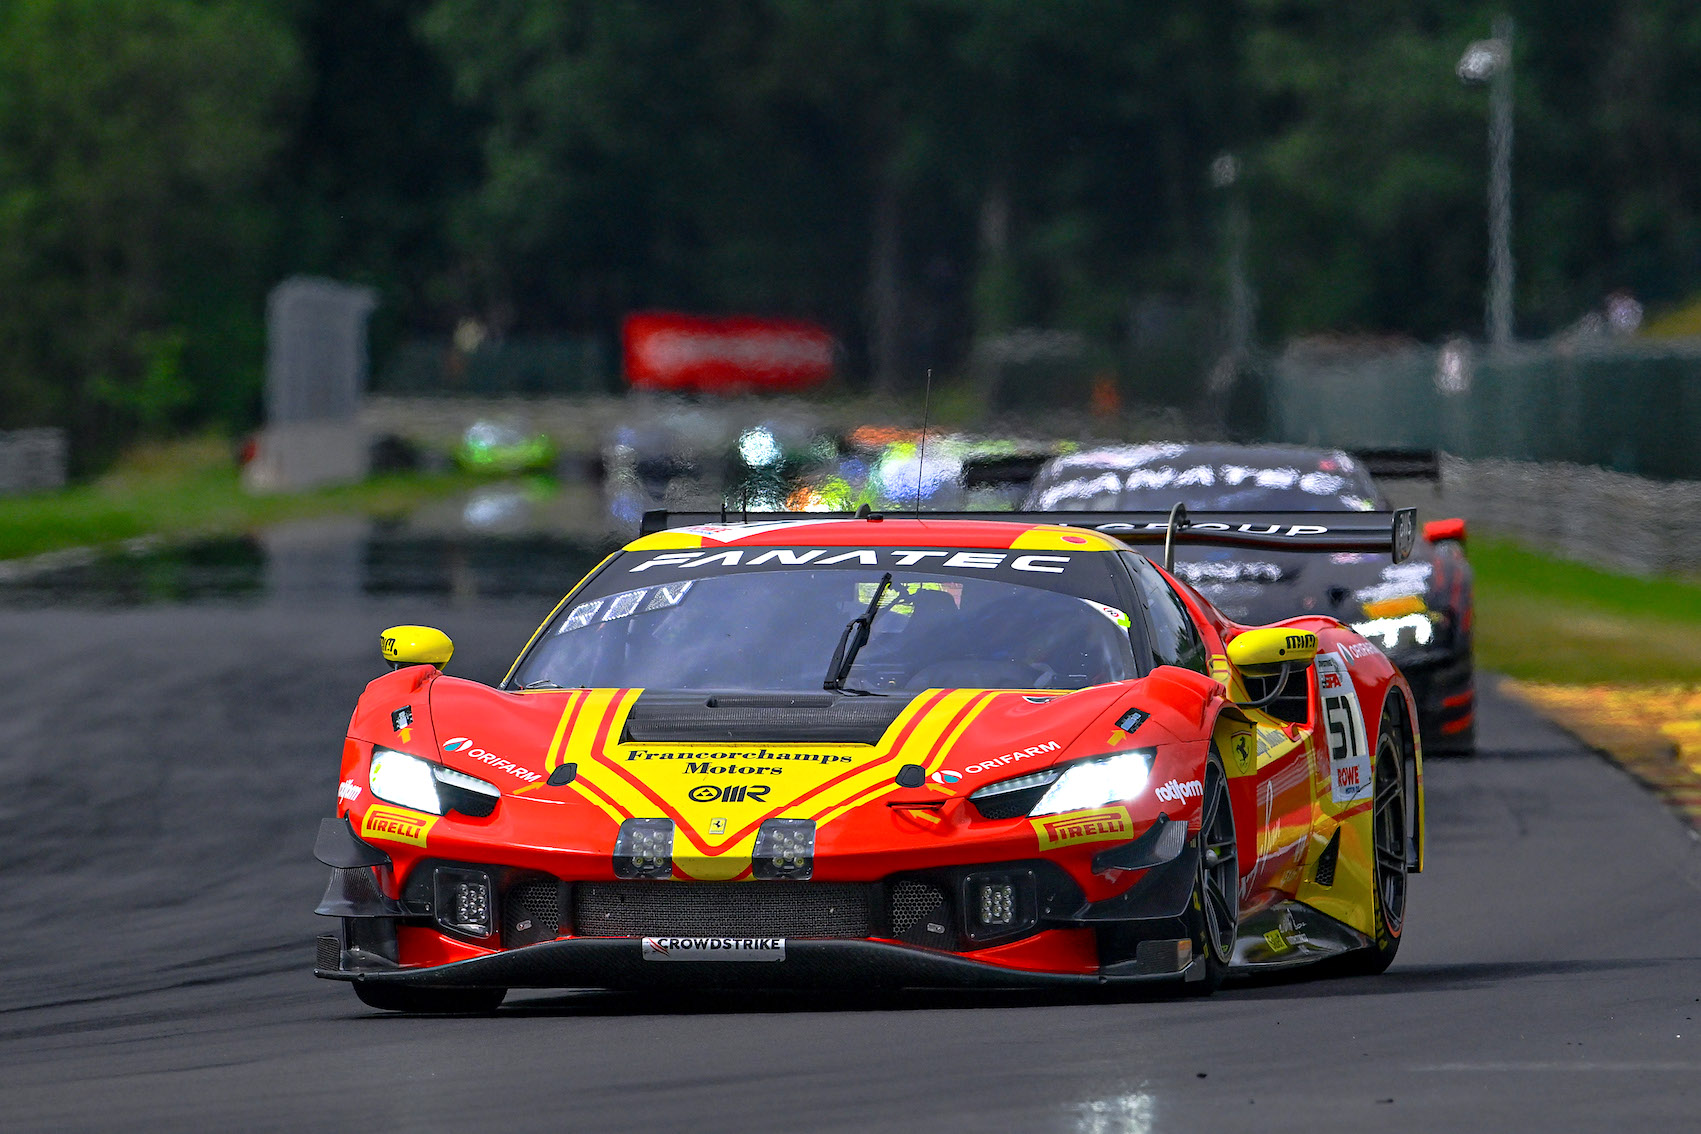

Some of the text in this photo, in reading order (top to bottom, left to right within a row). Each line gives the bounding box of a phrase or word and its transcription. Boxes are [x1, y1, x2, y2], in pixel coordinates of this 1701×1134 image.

[630, 549, 1072, 574] FANATEC
[1325, 695, 1357, 760] 51
[467, 747, 542, 782] ORIFARM
[626, 748, 853, 767] Francorchamps
[683, 761, 784, 776] Motors
[965, 740, 1061, 775] ORIFARM
[1336, 765, 1360, 787] ROWE
[1154, 779, 1204, 806] rotiform
[366, 810, 428, 840] PIRELLI
[1043, 809, 1126, 844] PIRELLI
[657, 938, 781, 951] CROWDSTRIKE
